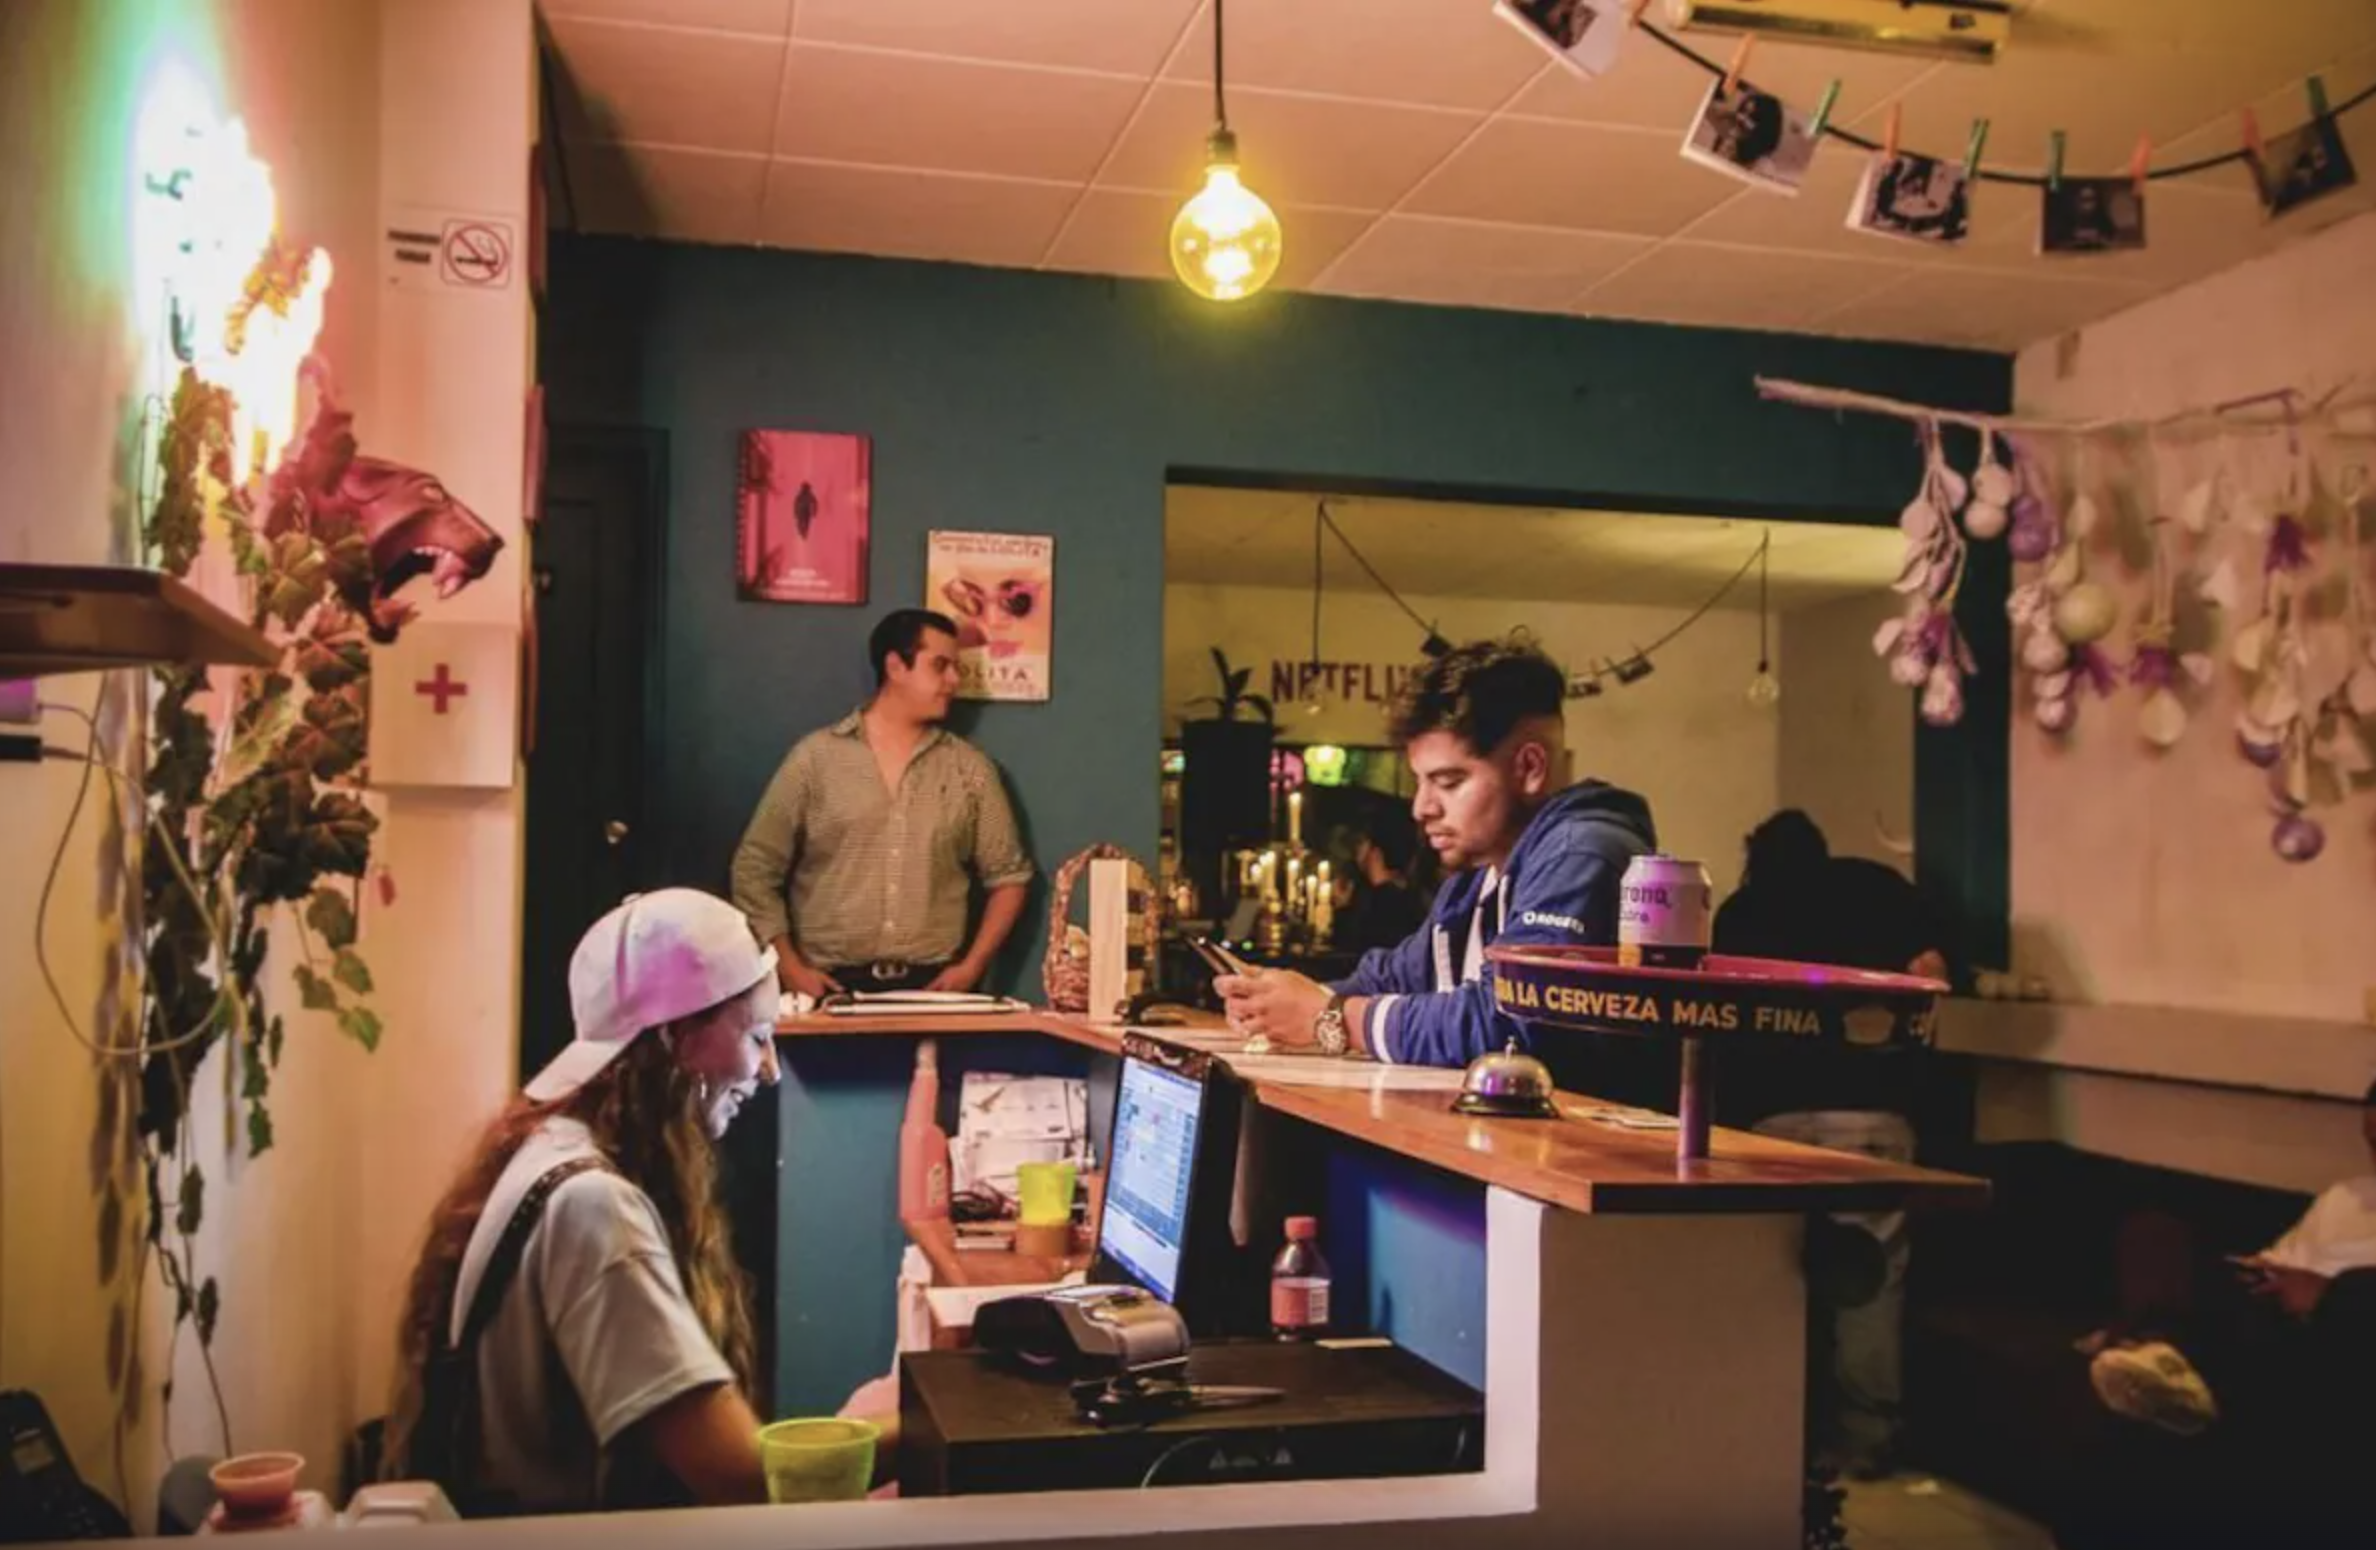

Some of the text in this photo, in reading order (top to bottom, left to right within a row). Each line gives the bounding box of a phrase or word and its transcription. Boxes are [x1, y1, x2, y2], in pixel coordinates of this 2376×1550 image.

[1516, 981, 1540, 1008] LA
[1544, 984, 1660, 1023] CERVEZA
[1671, 999, 1738, 1030] MAS
[1754, 1005, 1822, 1037] FINA
